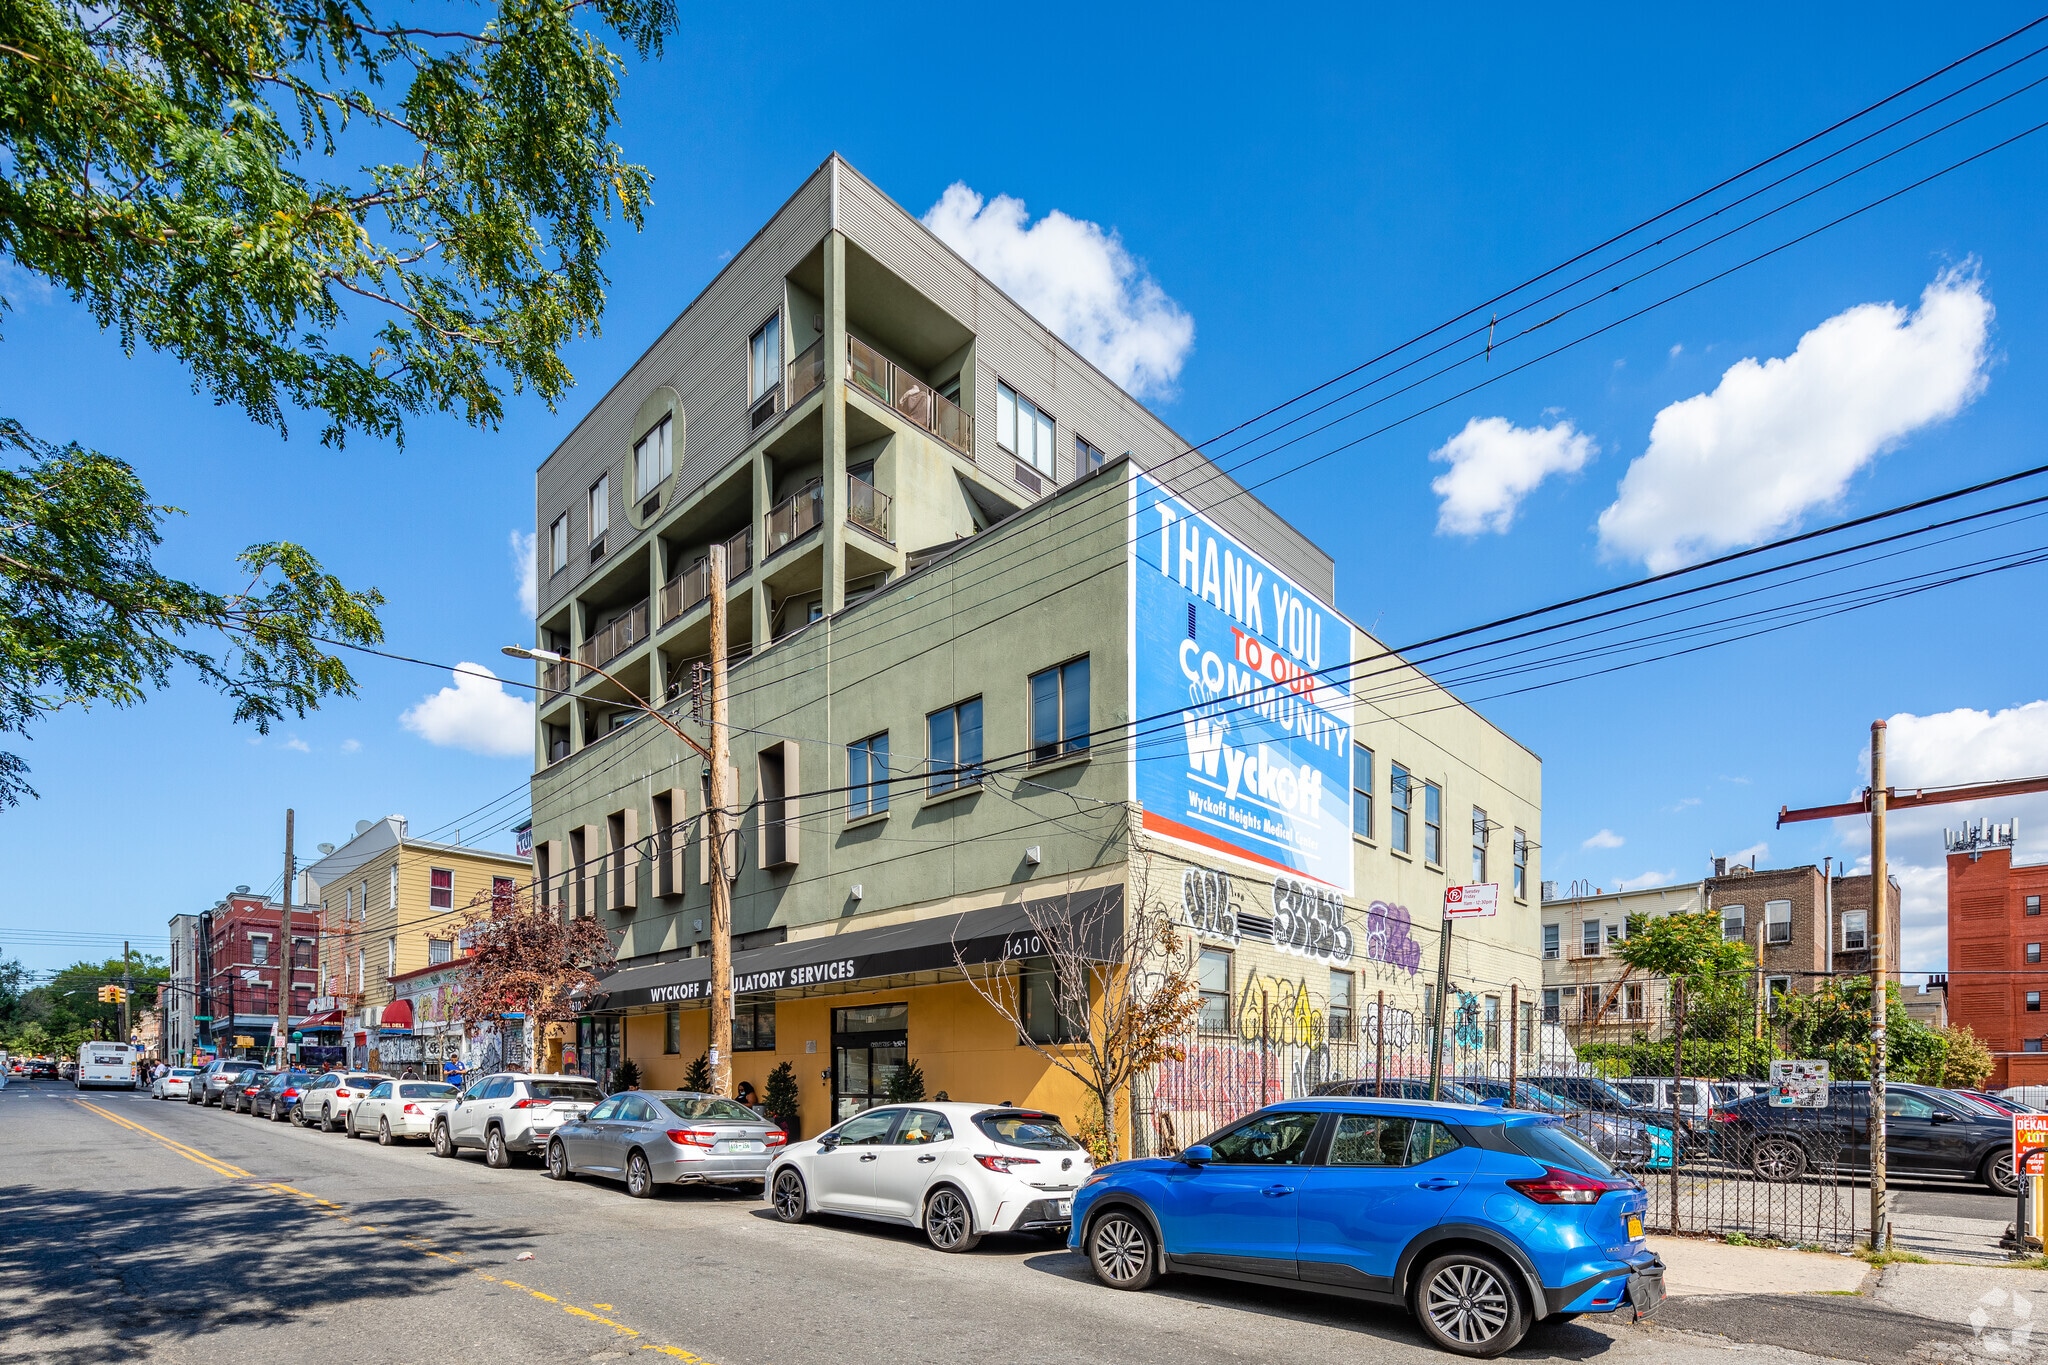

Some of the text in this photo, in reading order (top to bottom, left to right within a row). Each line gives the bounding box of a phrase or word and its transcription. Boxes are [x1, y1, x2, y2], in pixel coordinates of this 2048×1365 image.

[1155, 499, 1321, 670] THANK YOU
[1179, 639, 1348, 757] COMMUNITY
[1231, 626, 1315, 704] TO OUR
[1183, 710, 1322, 819] Wyckoff
[1188, 790, 1319, 850] Wyckoff Heights Medical Center
[650, 959, 855, 1002] WYCKOFF AULATORY SERVICES
[1006, 936, 1040, 957] 1610
